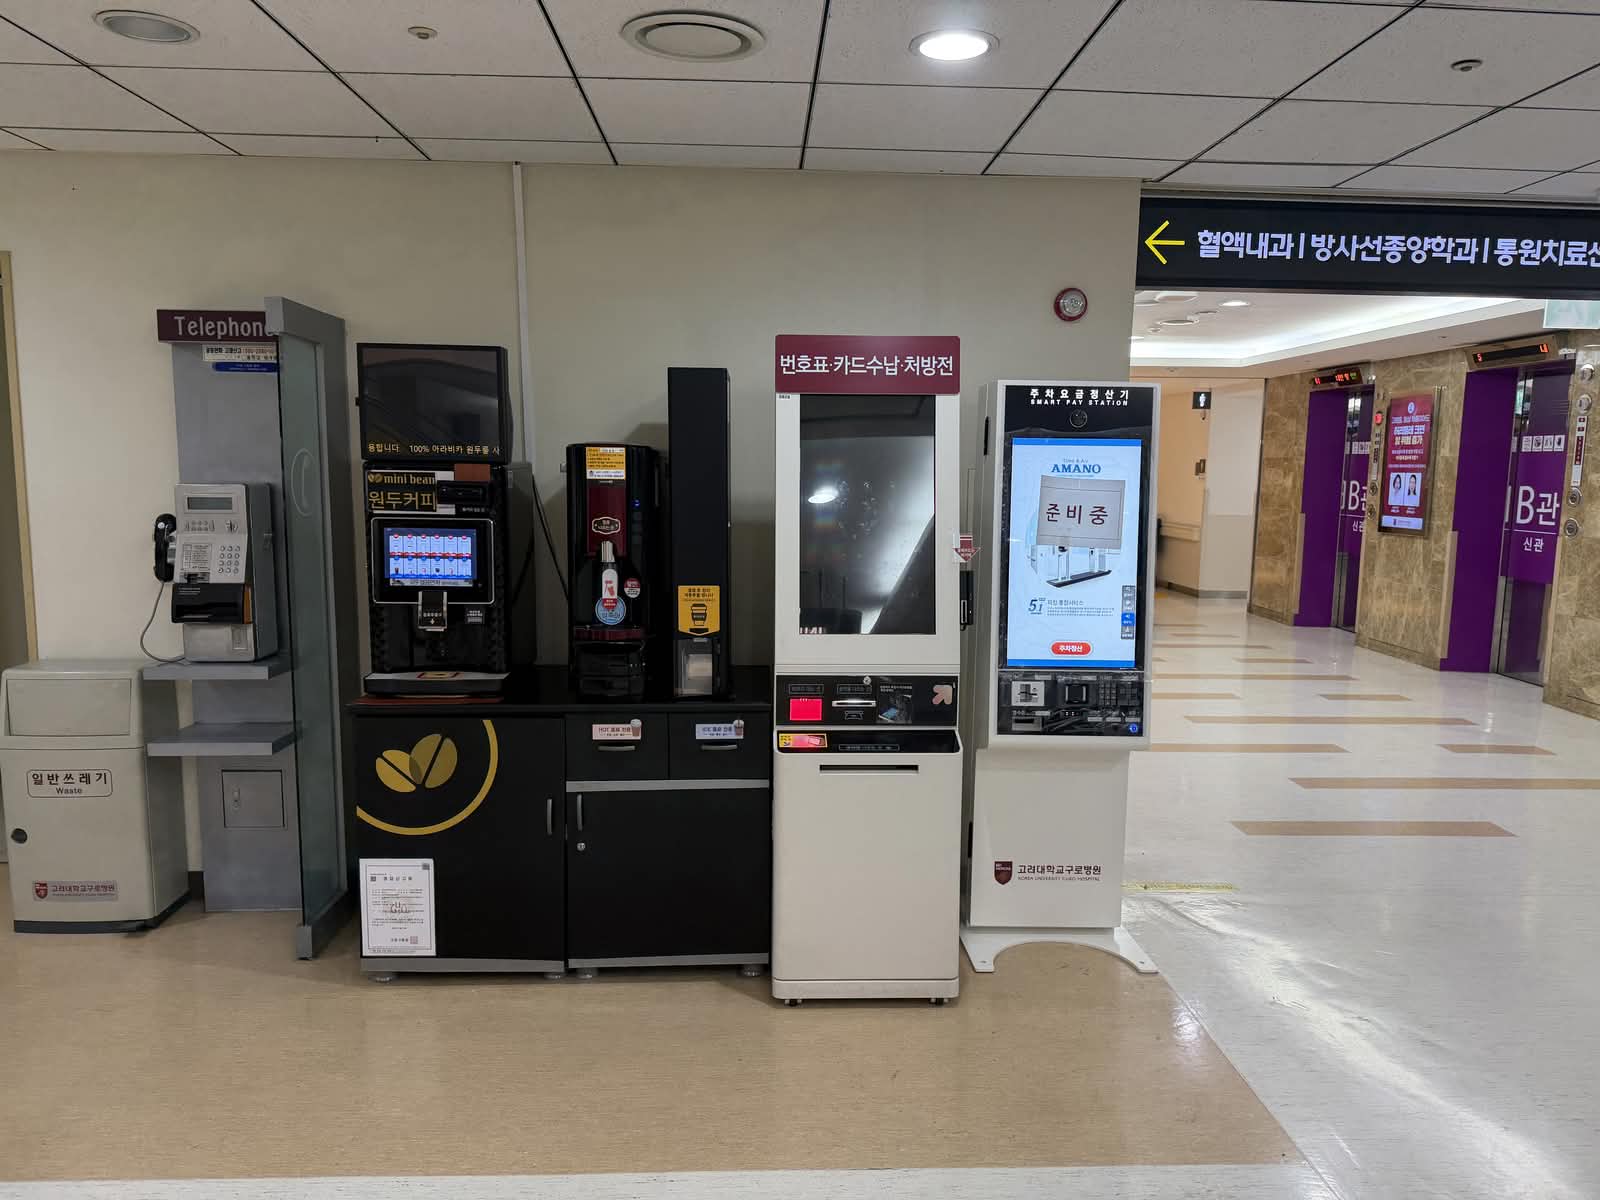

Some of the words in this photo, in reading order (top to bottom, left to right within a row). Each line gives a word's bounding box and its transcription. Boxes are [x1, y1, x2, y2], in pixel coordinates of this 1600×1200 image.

[1198, 230, 1294, 259] 혈액내과
[1311, 234, 1478, 264] 방사선종양학과
[409, 445, 431, 454] 100%
[431, 445, 463, 454] 아라비카
[1051, 464, 1101, 474] AMANO
[384, 474, 407, 484] mini
[409, 475, 435, 486] bean
[368, 490, 436, 510] 원두커피
[1516, 485, 1560, 526] B관
[1523, 537, 1544, 553] 신관
[32, 773, 107, 785] 일반쓰레기
[1018, 865, 1101, 875] 고려대학교구로병원
